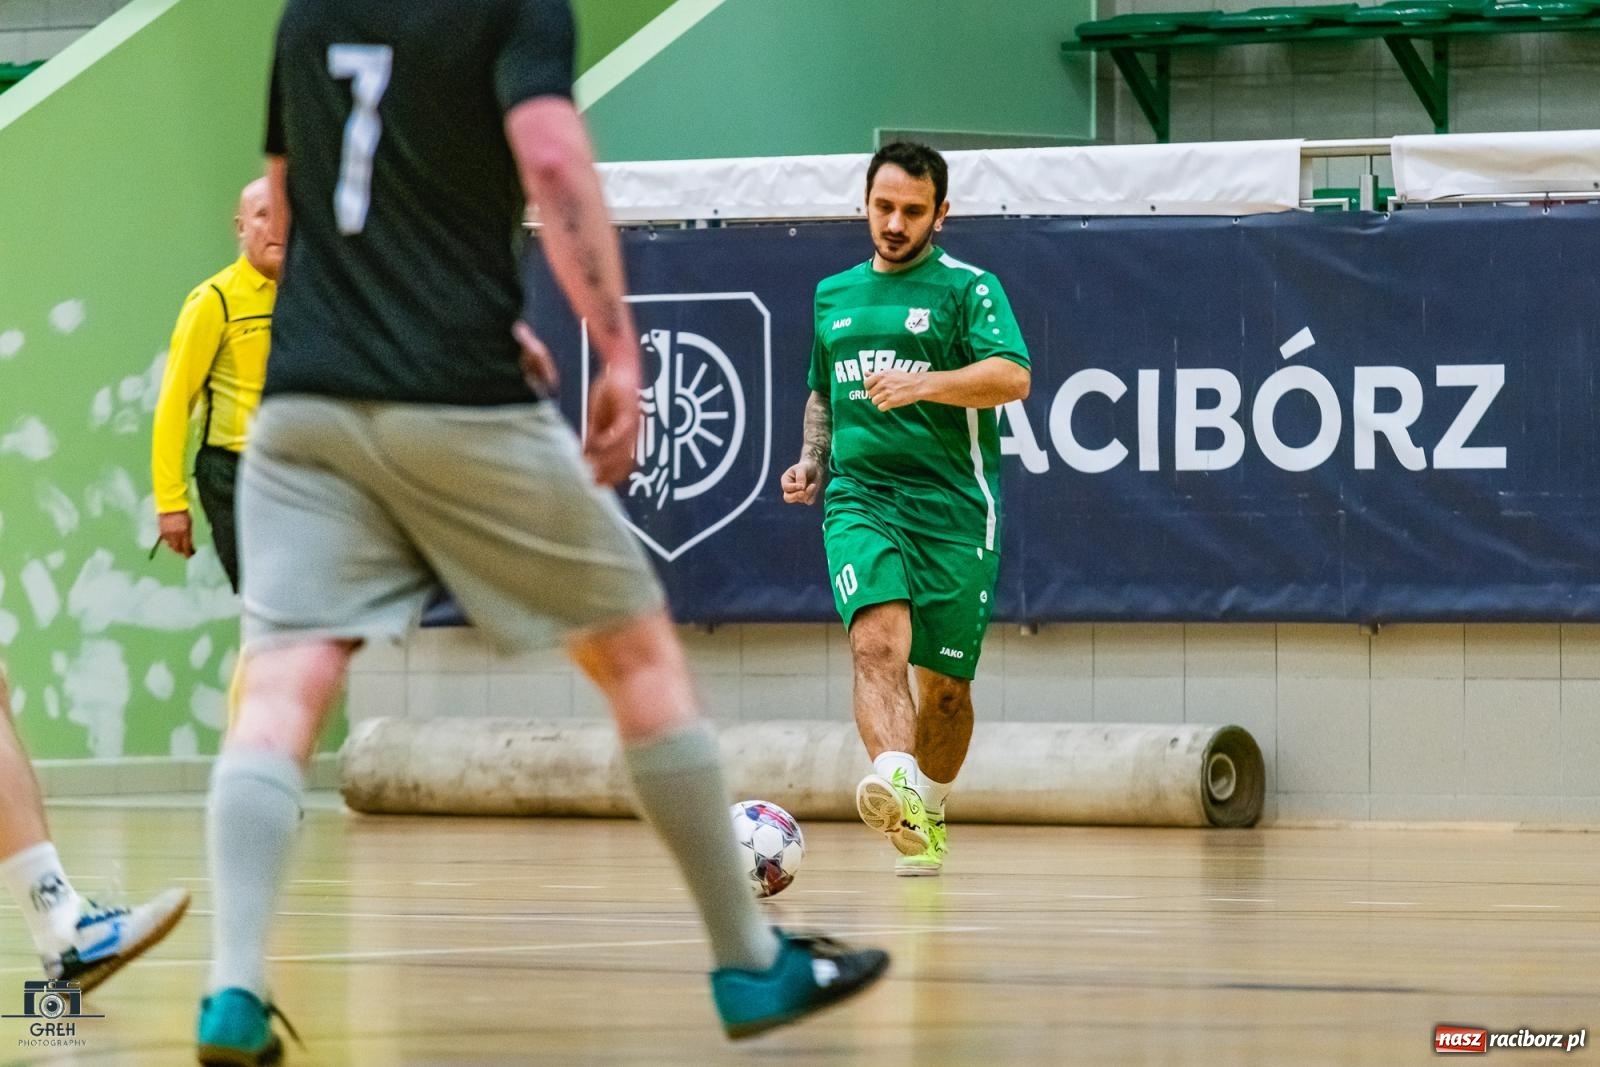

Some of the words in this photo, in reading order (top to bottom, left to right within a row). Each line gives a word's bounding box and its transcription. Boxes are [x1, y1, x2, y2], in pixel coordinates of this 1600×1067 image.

[326, 43, 394, 236] 7
[832, 317, 852, 330] JAKO
[849, 390, 872, 400] GRU
[994, 326, 1507, 474] ACIBÓRZ
[835, 563, 858, 605] 10
[940, 647, 964, 659] JAKO
